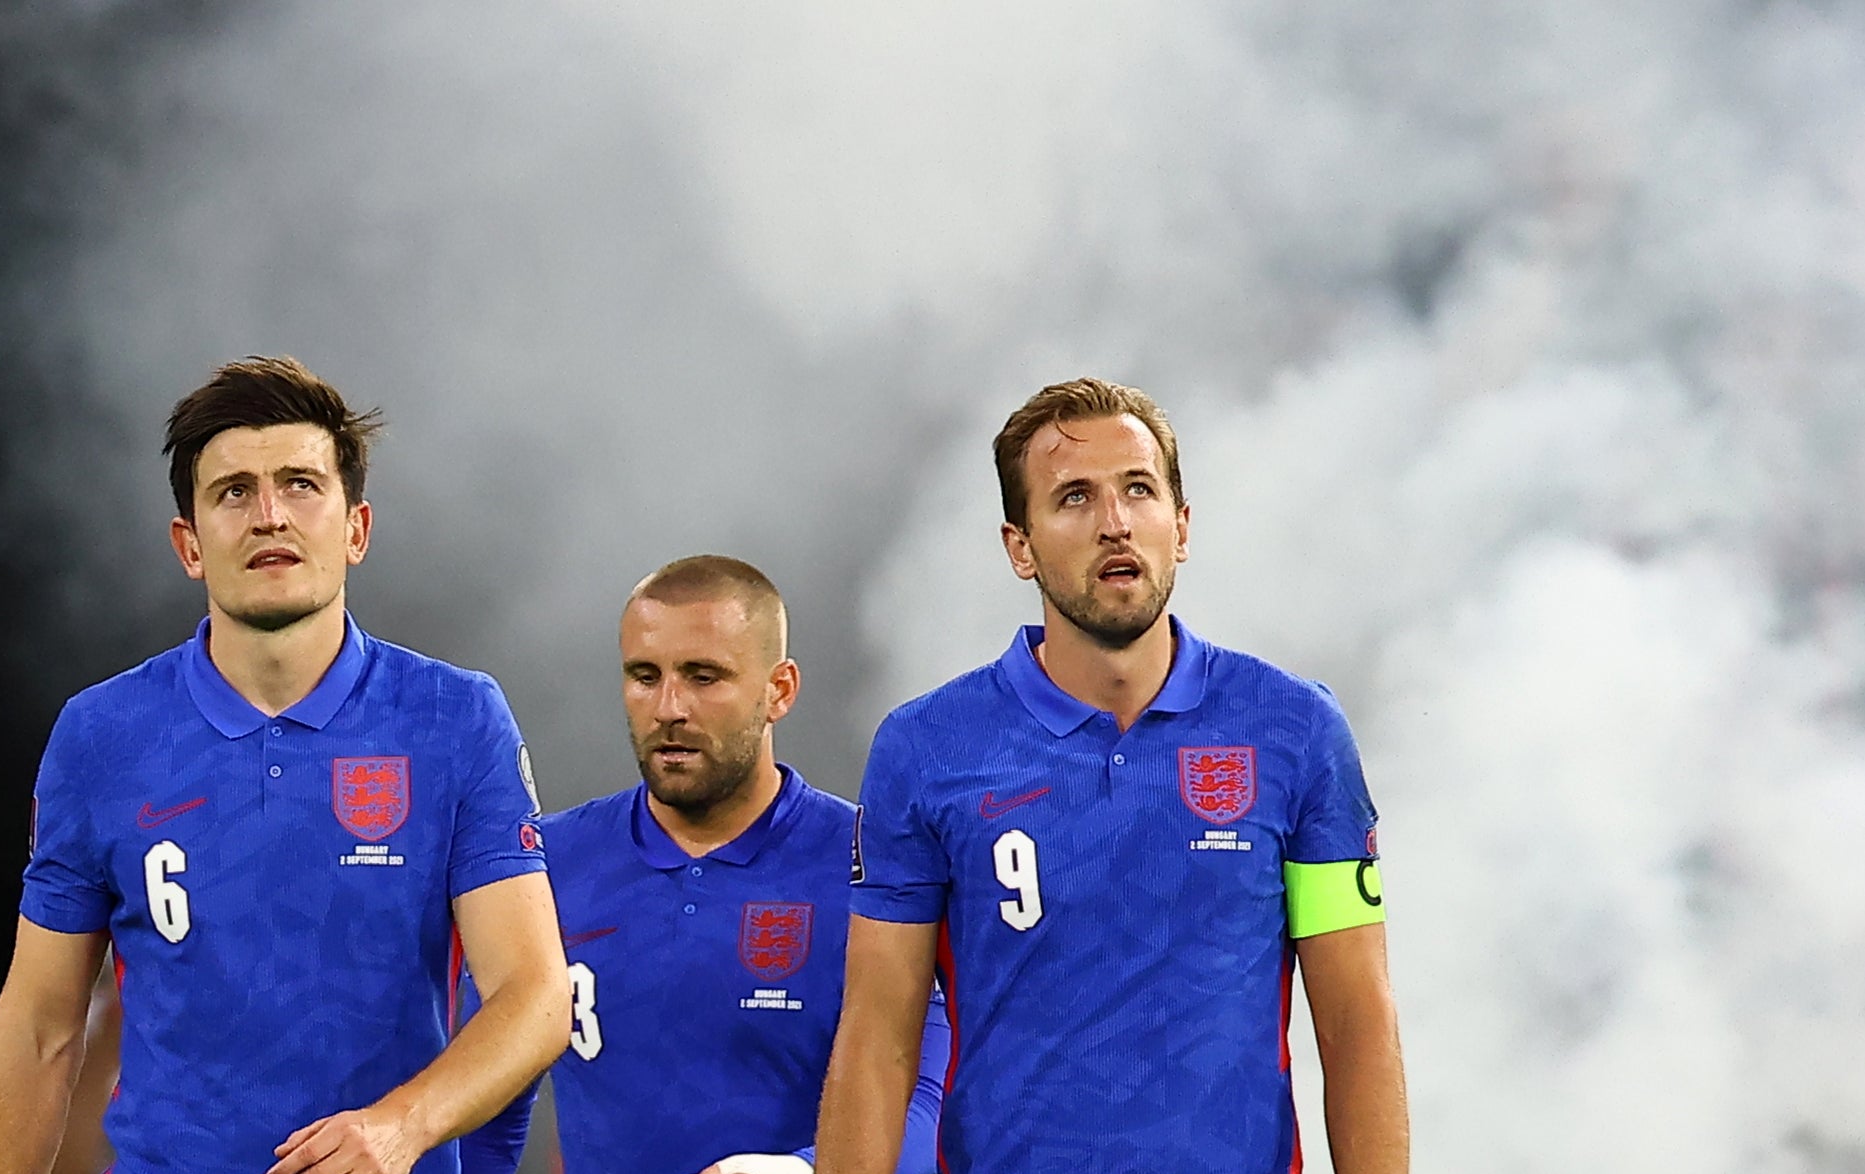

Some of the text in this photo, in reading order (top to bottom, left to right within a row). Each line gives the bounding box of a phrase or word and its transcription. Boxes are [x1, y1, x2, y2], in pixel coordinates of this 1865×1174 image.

[143, 839, 191, 944] 6
[992, 828, 1044, 932] 9
[1355, 859, 1382, 907] C
[566, 961, 605, 1062] 3
